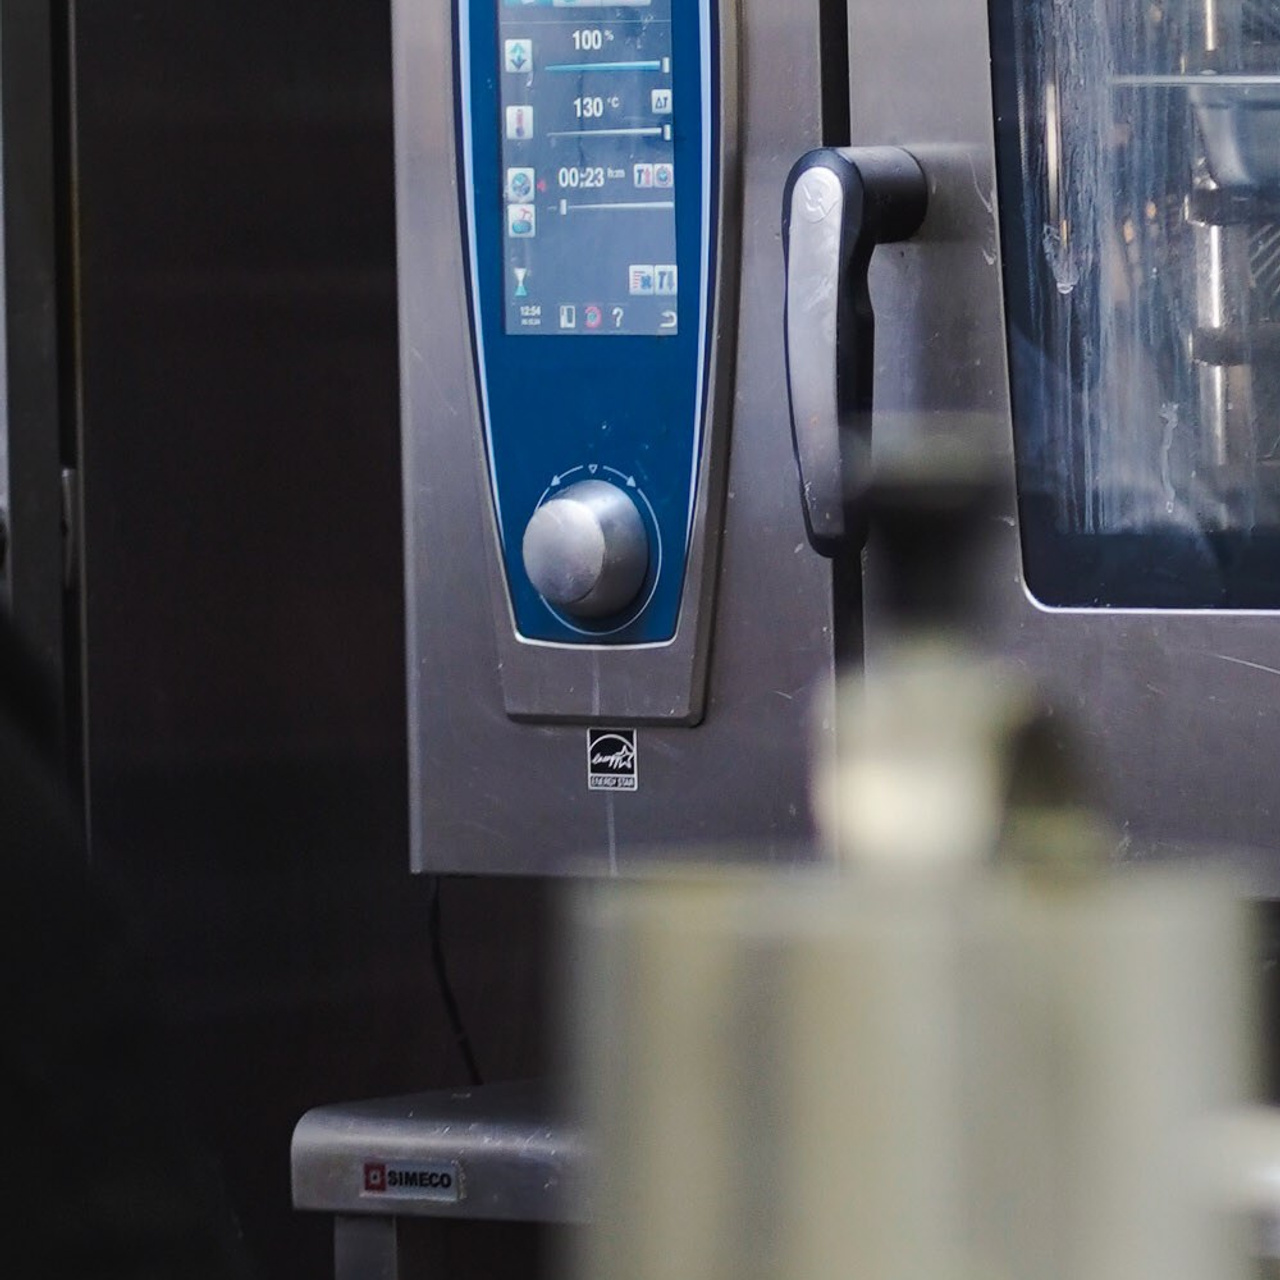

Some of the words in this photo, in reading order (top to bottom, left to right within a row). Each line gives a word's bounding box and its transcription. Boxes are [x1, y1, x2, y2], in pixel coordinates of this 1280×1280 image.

[572, 30, 602, 50] 100
[574, 97, 604, 118] 130
[559, 167, 604, 188] 00:23
[388, 1170, 452, 1188] SIMECO
